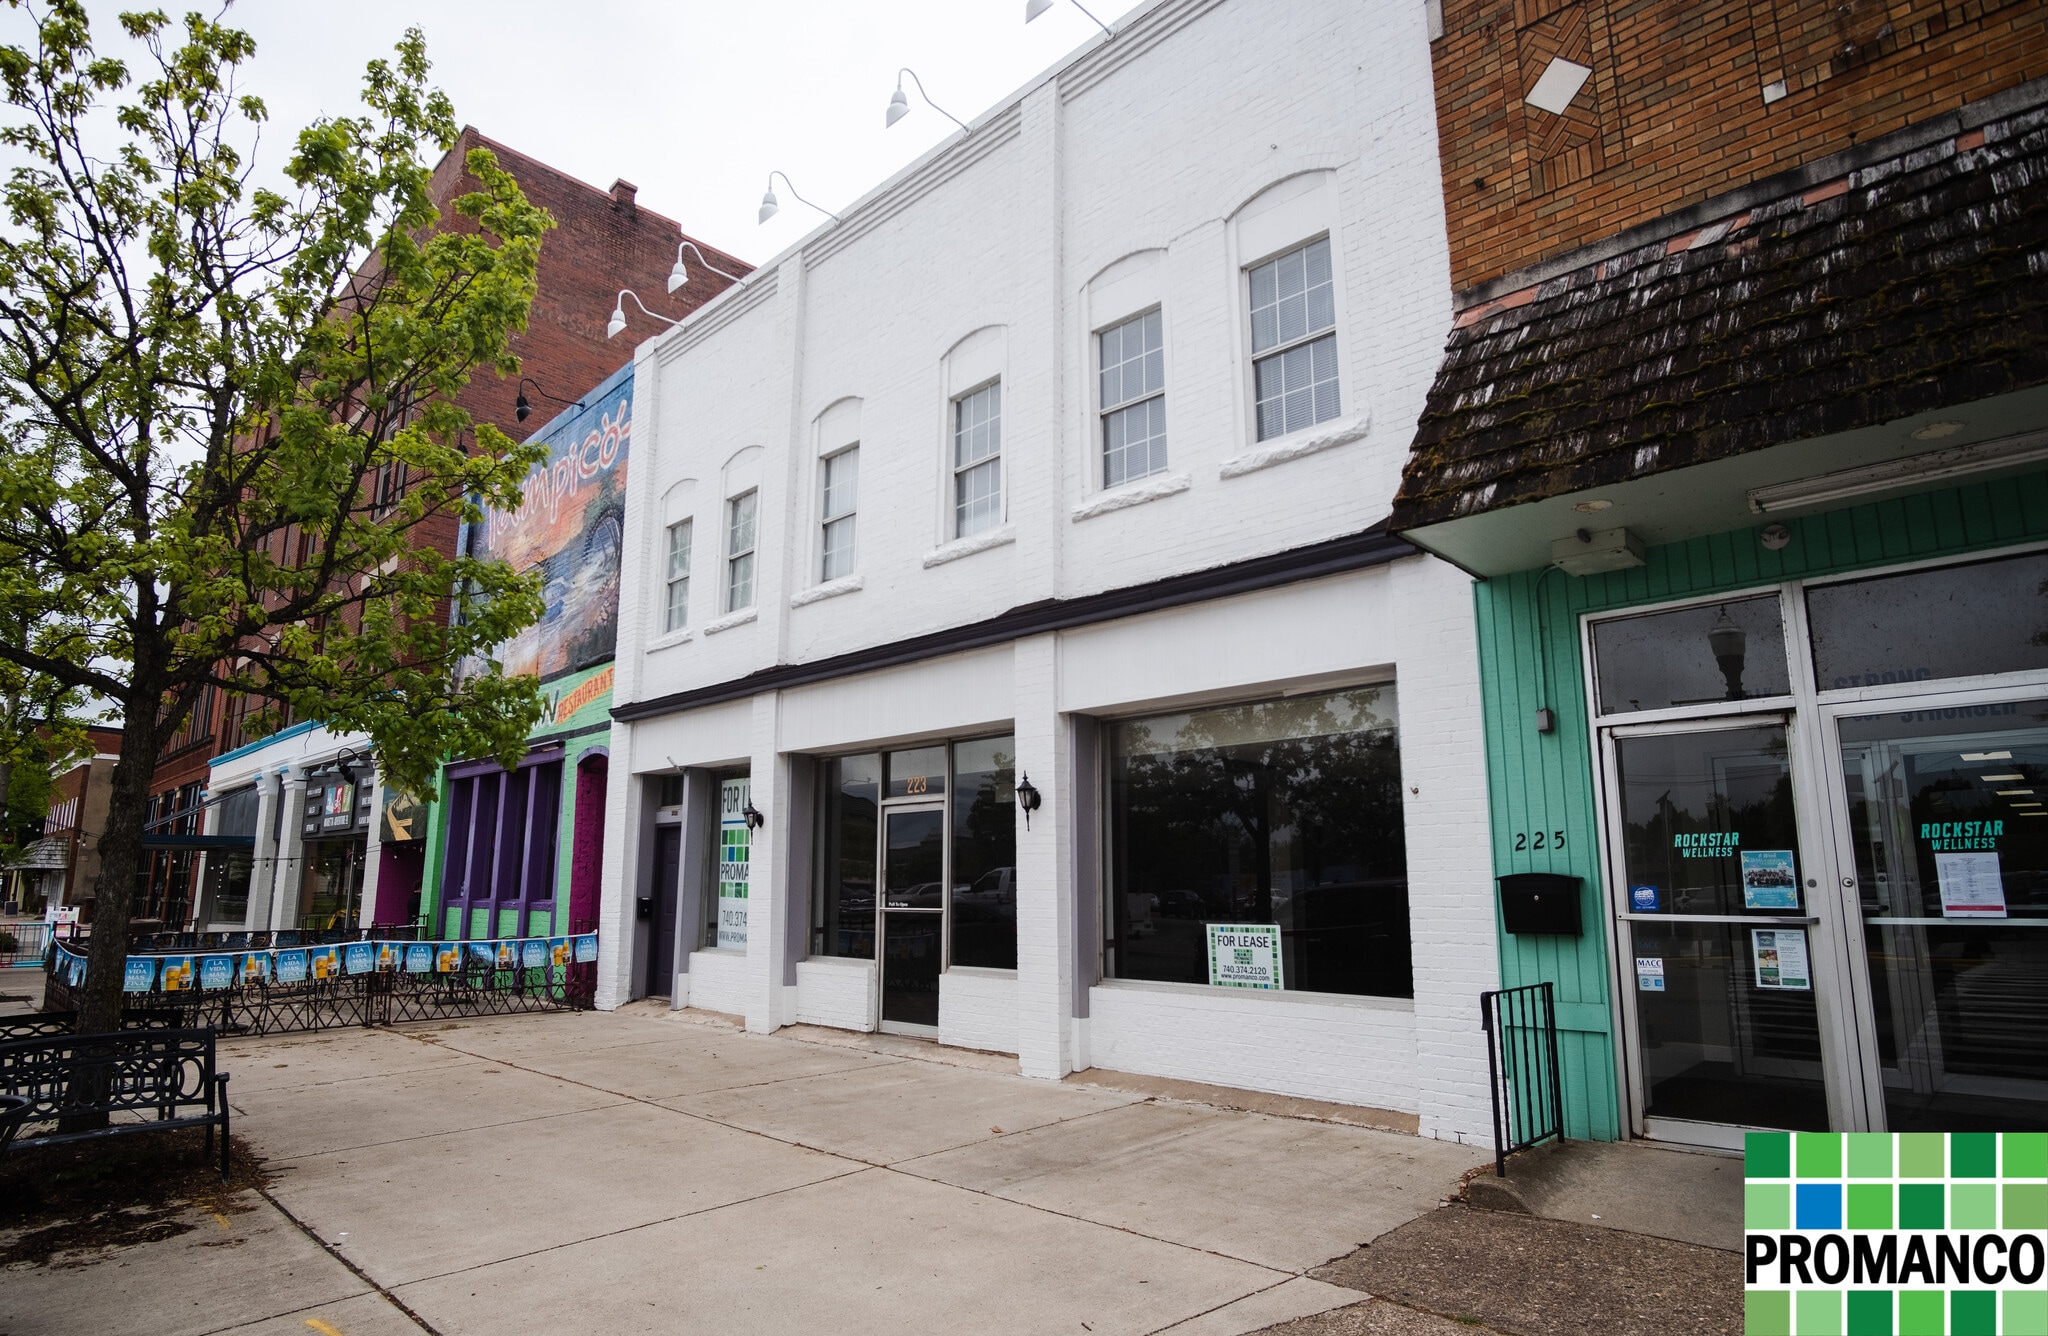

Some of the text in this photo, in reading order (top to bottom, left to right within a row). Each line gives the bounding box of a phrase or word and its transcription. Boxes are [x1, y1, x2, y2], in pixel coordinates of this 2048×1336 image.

[557, 667, 615, 724] RESTAURANT
[907, 776, 926, 793] 223
[722, 785, 740, 813] FOR
[1921, 820, 2004, 839] ROCKSTAR
[1515, 831, 1565, 851] 225
[1674, 832, 1740, 847] ROCKSTAR
[1931, 837, 1996, 850] WELLNESS
[1682, 847, 1733, 858] WELLNESS
[1217, 935, 1270, 949] FOR LEASE
[1223, 964, 1267, 976] 740.374.2120
[1638, 959, 1661, 967] MACC
[1221, 973, 1270, 982] www.promanco.com
